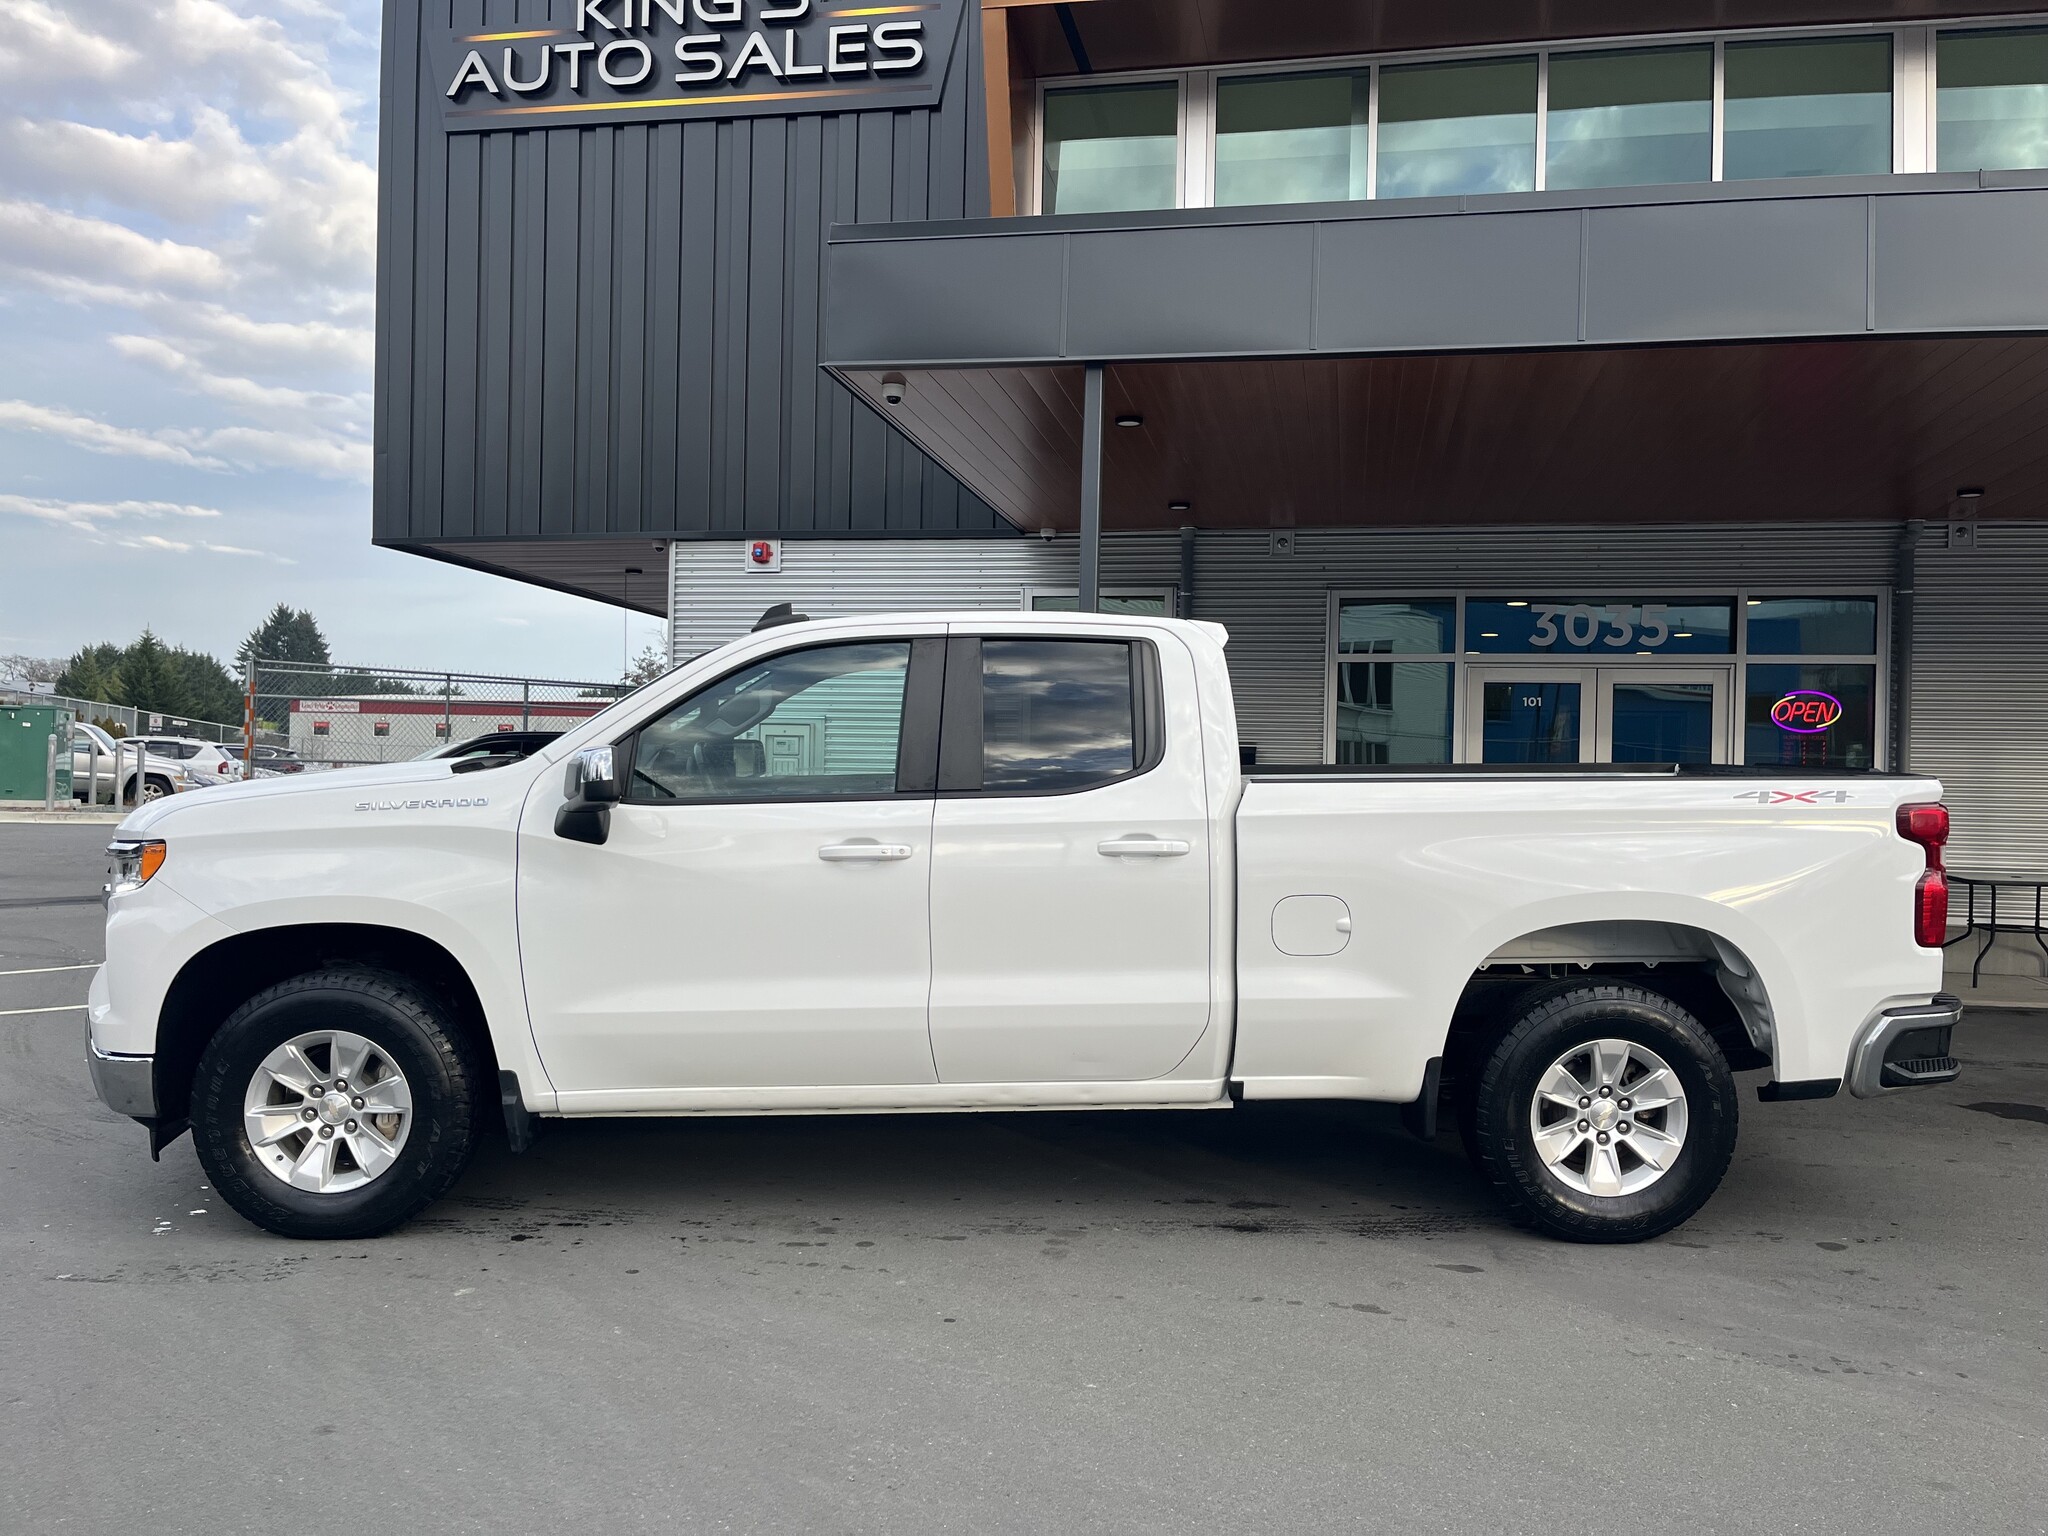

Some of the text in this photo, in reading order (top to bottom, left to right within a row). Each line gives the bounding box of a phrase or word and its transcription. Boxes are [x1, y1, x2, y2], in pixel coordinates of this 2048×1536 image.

[446, 20, 924, 98] AUTO SALES
[1528, 603, 1669, 647] 3035
[1522, 697, 1542, 707] 101
[1774, 701, 1836, 723] OPEN
[355, 797, 490, 811] SILVERADO
